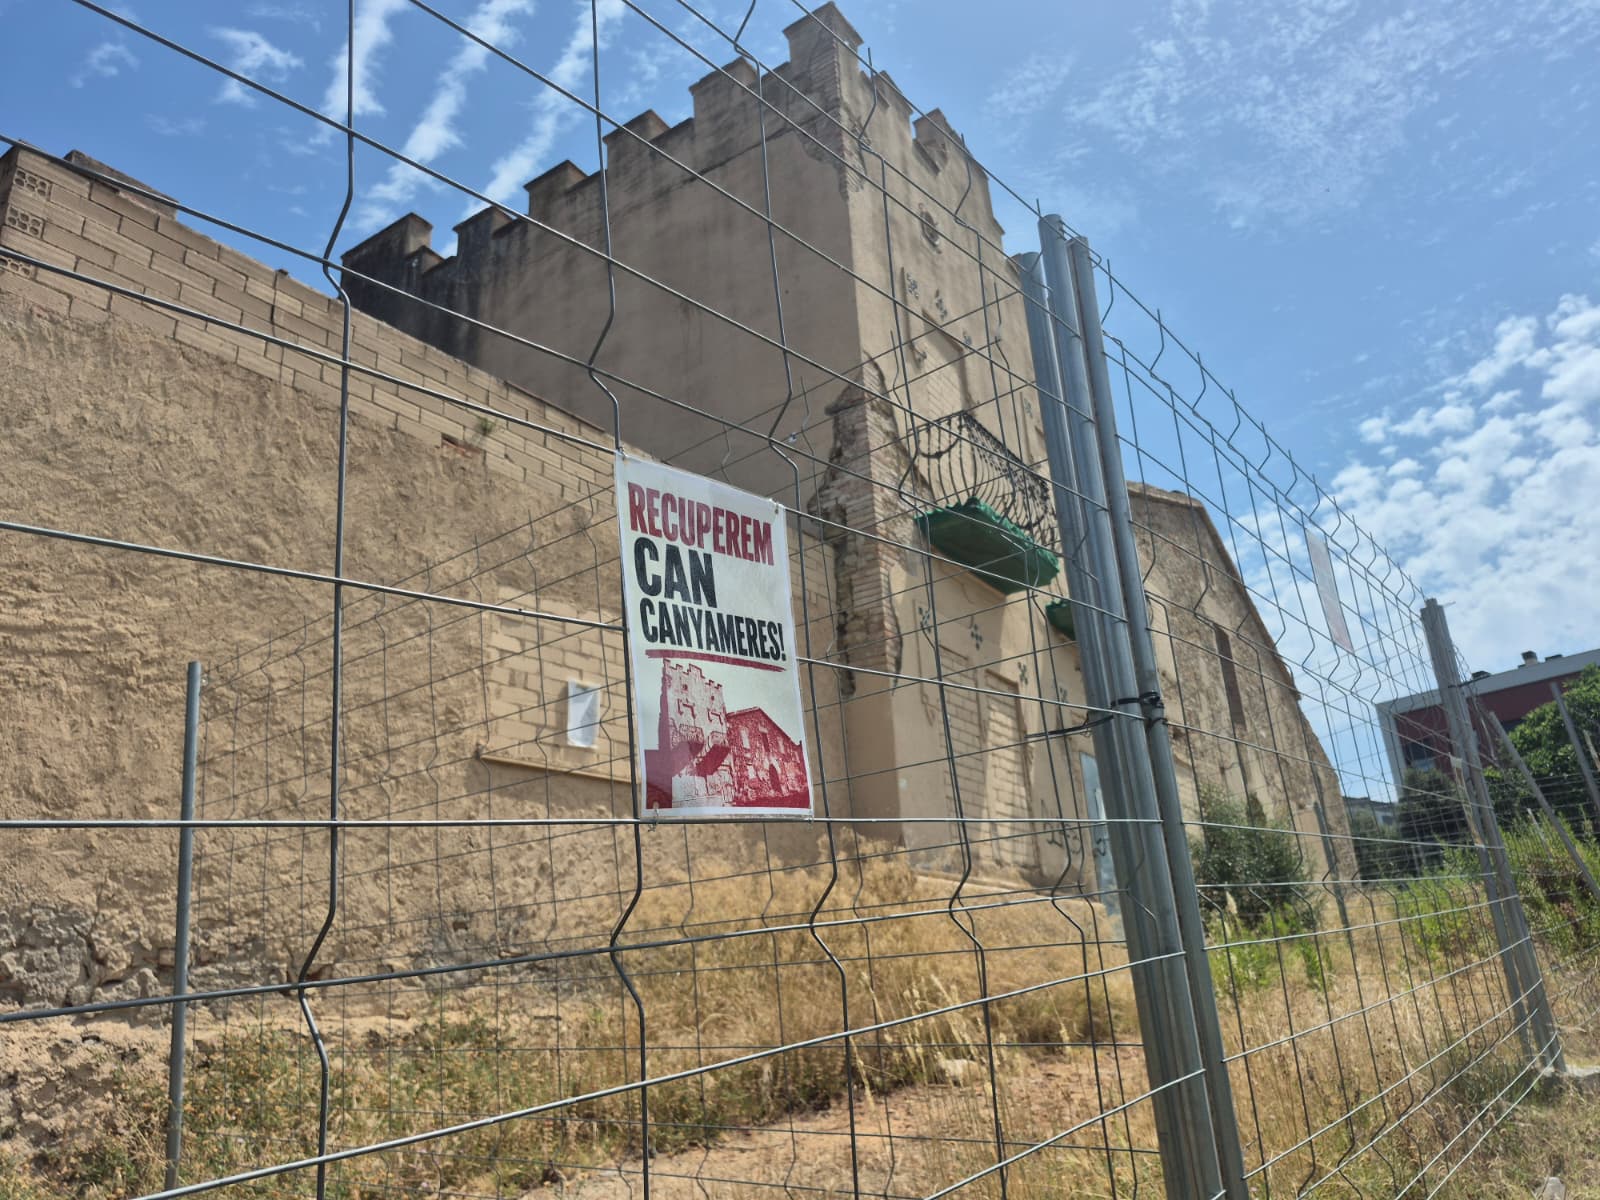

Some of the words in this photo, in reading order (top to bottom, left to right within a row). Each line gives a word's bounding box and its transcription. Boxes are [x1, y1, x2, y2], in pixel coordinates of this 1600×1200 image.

[628, 482, 774, 566] RECUPEREM
[634, 537, 717, 608] CAN
[640, 598, 786, 661] CANYAMERES!
